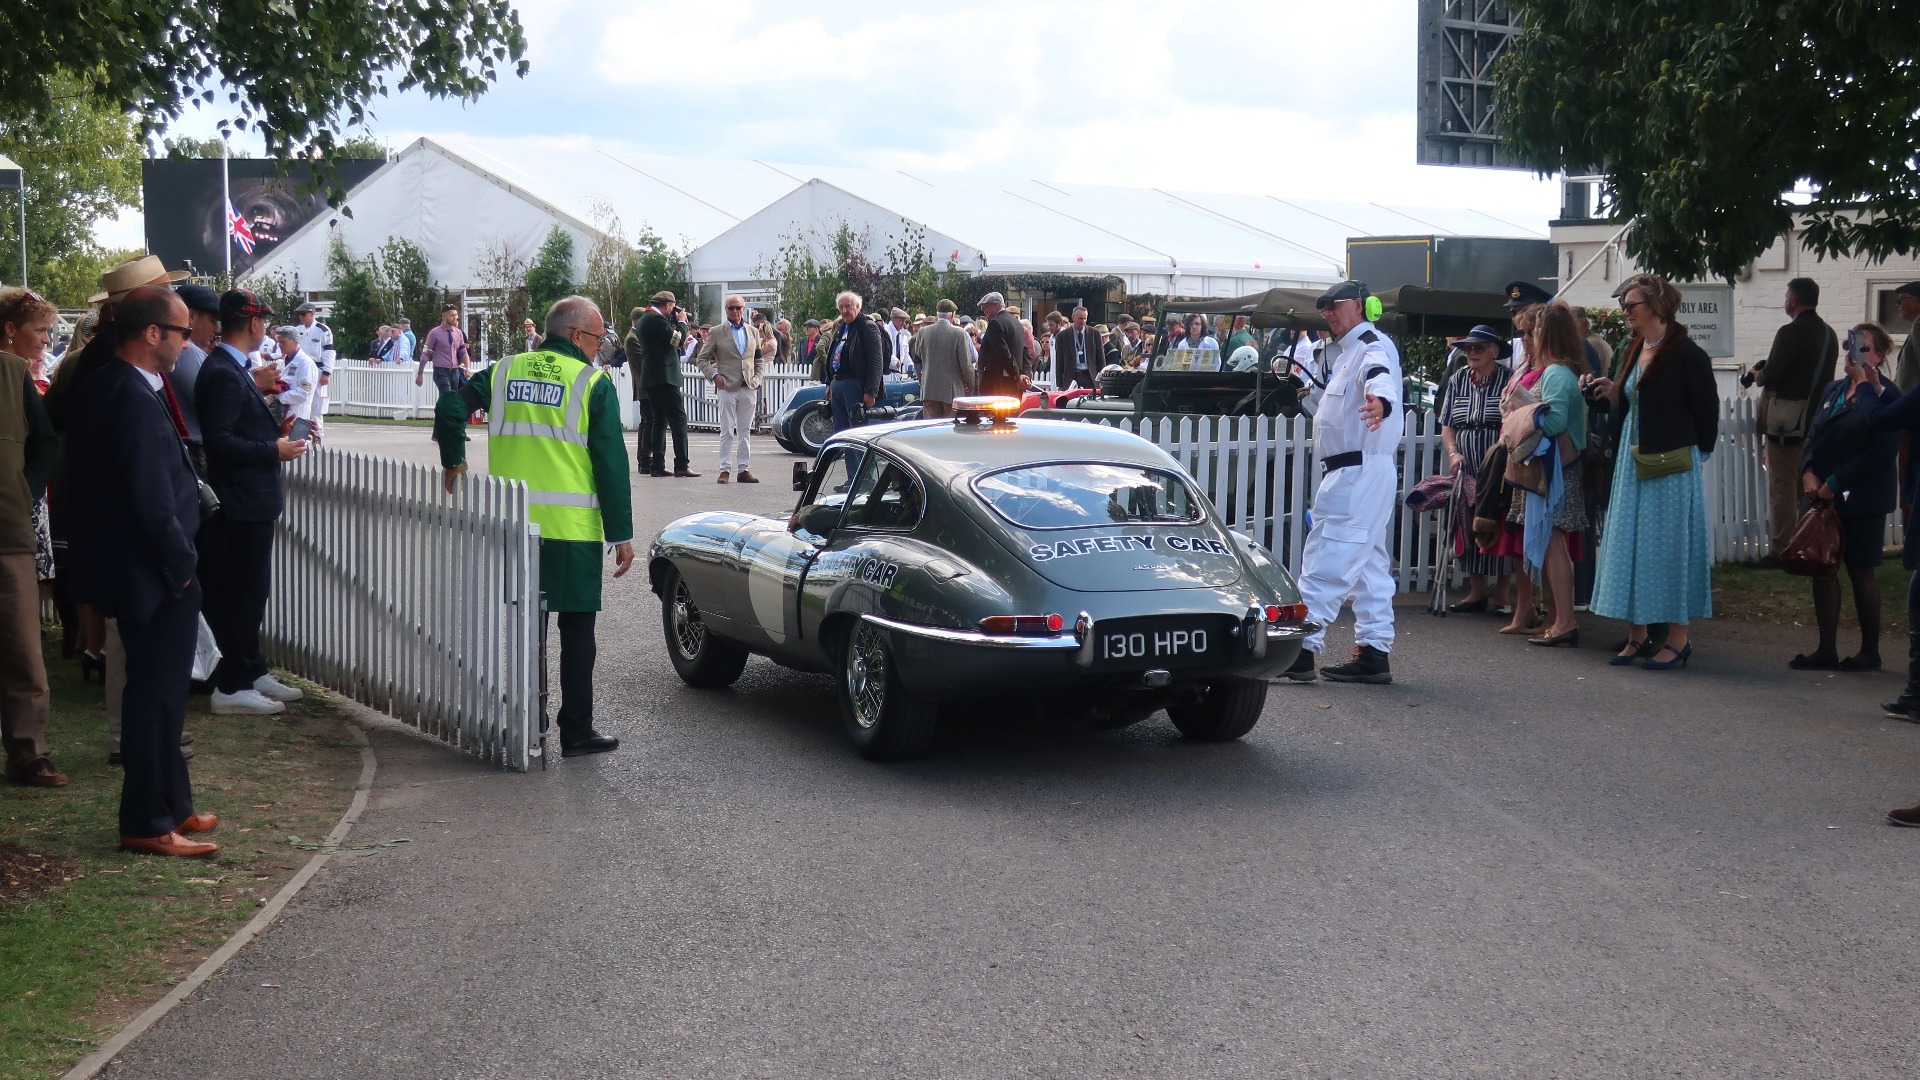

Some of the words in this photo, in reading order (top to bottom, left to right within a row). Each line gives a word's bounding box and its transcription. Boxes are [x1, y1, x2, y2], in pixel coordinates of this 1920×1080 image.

[1698, 302, 1718, 313] AREA
[509, 381, 561, 404] STEWARD
[1029, 534, 1156, 562] SAFETY
[1165, 536, 1236, 557] CAR
[861, 558, 899, 590] CAR
[1103, 633, 1146, 660] 130
[1153, 629, 1209, 657] HPO
